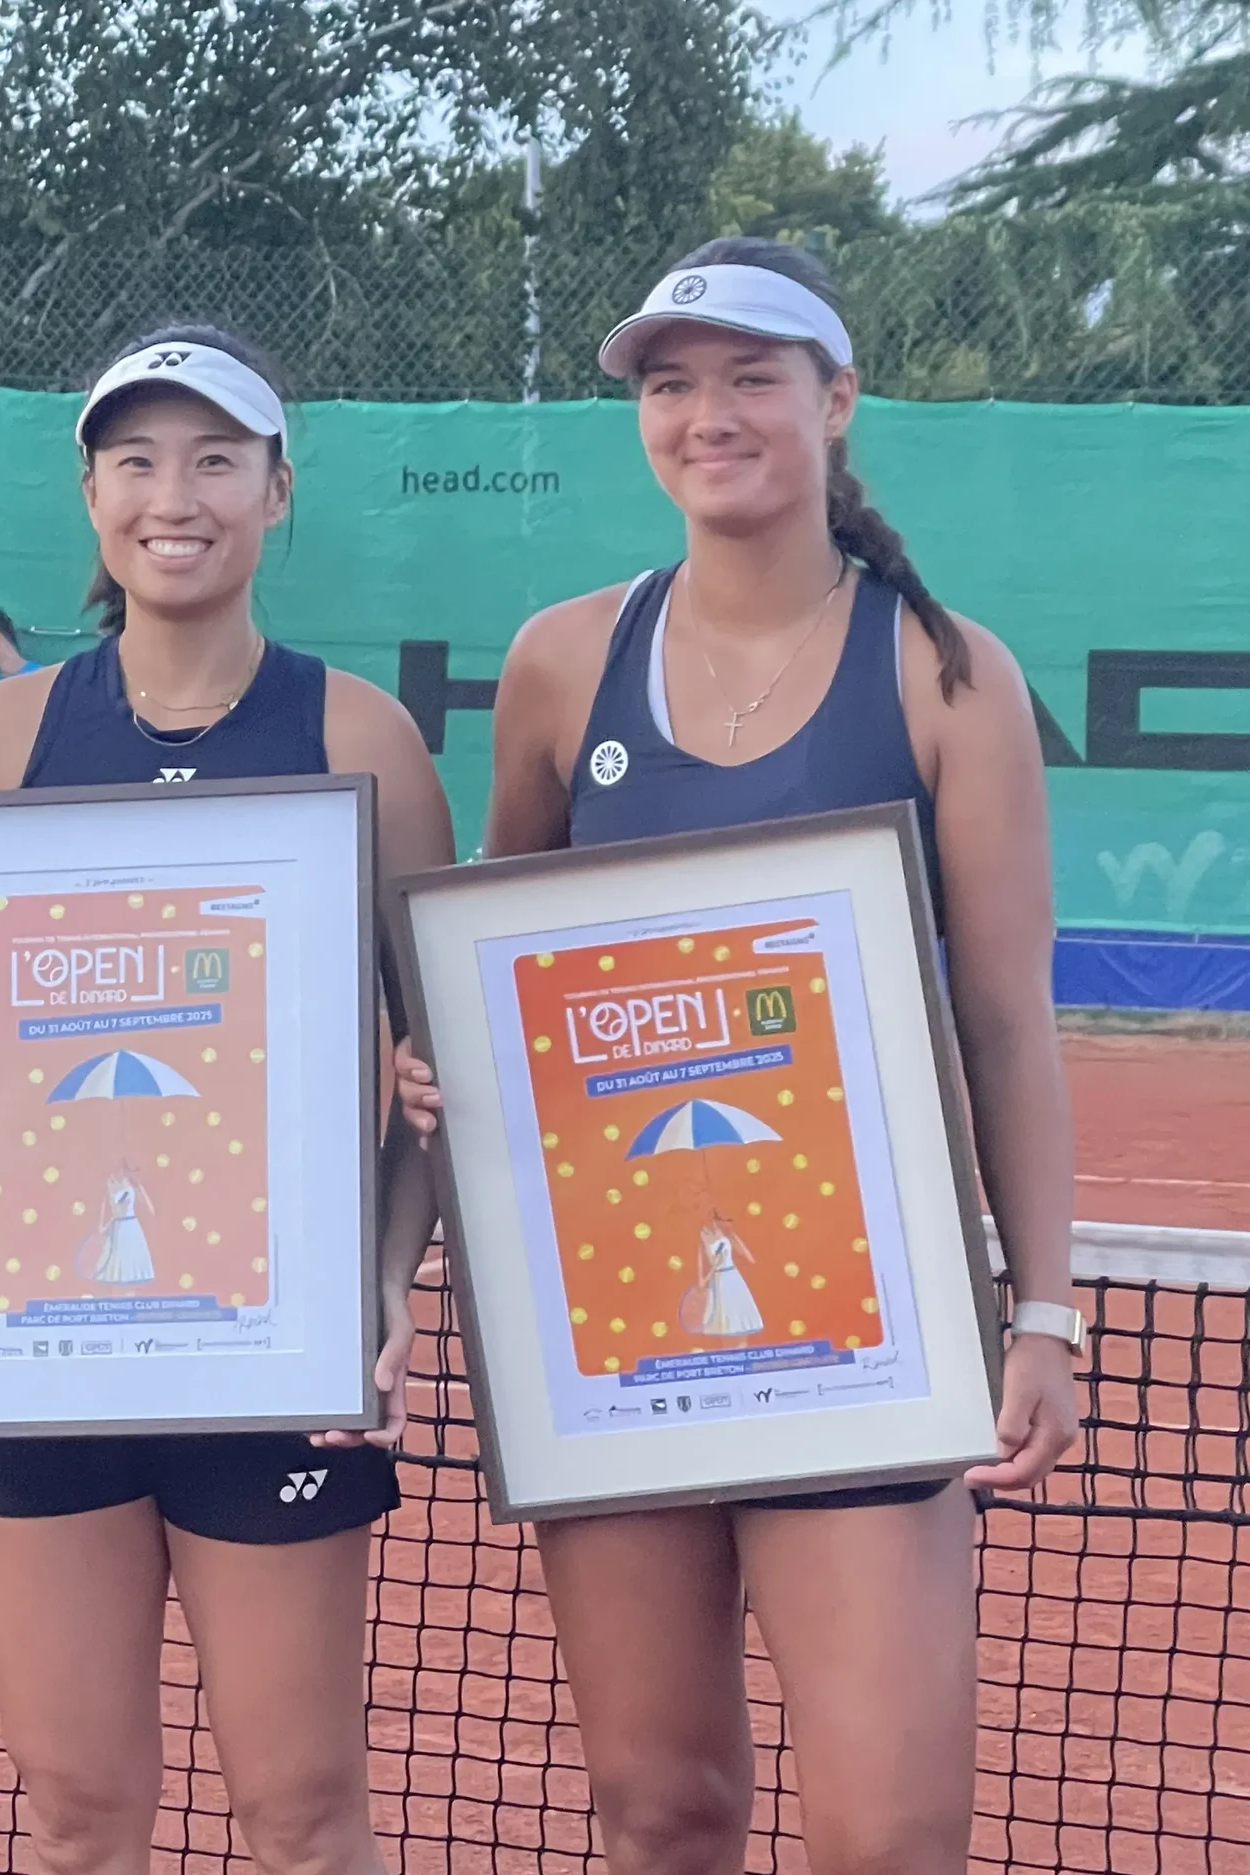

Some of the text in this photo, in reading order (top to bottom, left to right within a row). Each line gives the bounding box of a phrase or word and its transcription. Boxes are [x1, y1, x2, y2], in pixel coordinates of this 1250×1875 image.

[401, 464, 560, 494] head.com
[49, 990, 67, 1005] DE
[28, 1025, 47, 1035] DU
[60, 1020, 92, 1032] AOÛT
[93, 1019, 109, 1029] AU
[111, 1017, 117, 1029] 7
[119, 1012, 184, 1028] SEPTEMBRE
[612, 1044, 632, 1060] DE
[596, 1080, 614, 1092] DU
[629, 1071, 660, 1087] AOÛT
[662, 1069, 678, 1081] AU
[680, 1067, 686, 1078] 7
[688, 1058, 754, 1077] SEPTEMBRE
